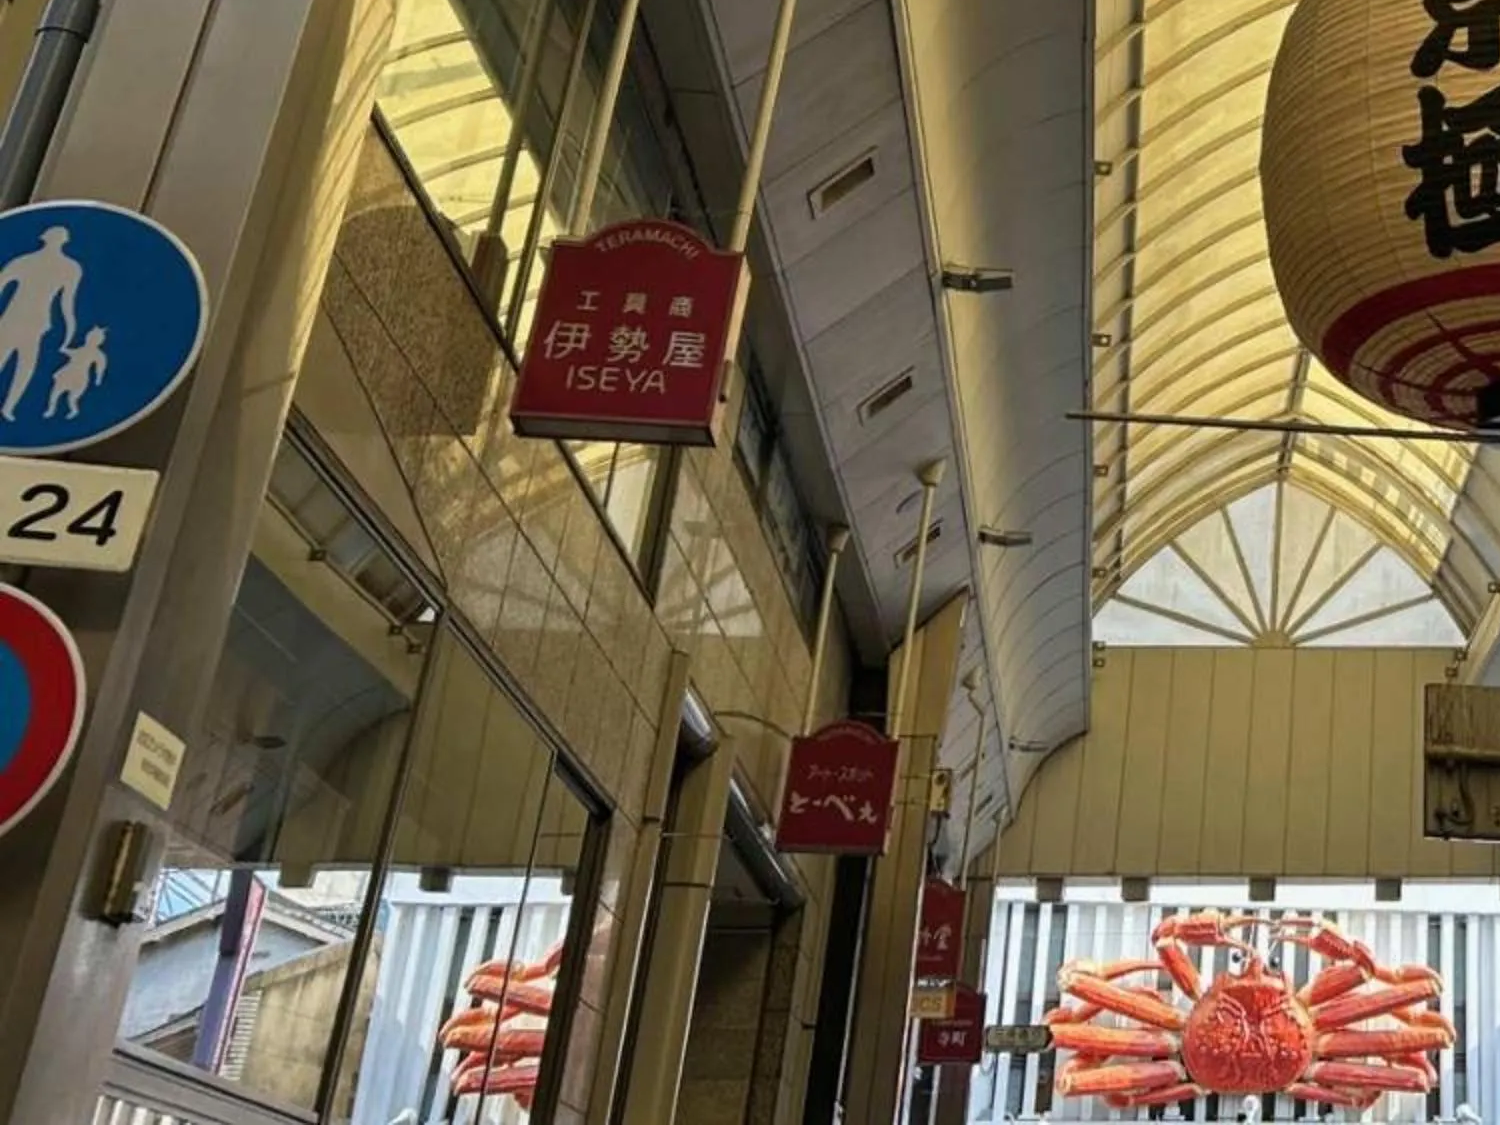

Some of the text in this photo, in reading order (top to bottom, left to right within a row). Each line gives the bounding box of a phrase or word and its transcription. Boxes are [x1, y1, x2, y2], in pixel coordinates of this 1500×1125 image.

[595, 228, 700, 260] TERAMACHI
[543, 320, 706, 368] 伊勢屋
[566, 366, 666, 395] ISEYA
[7, 483, 124, 546] 24
